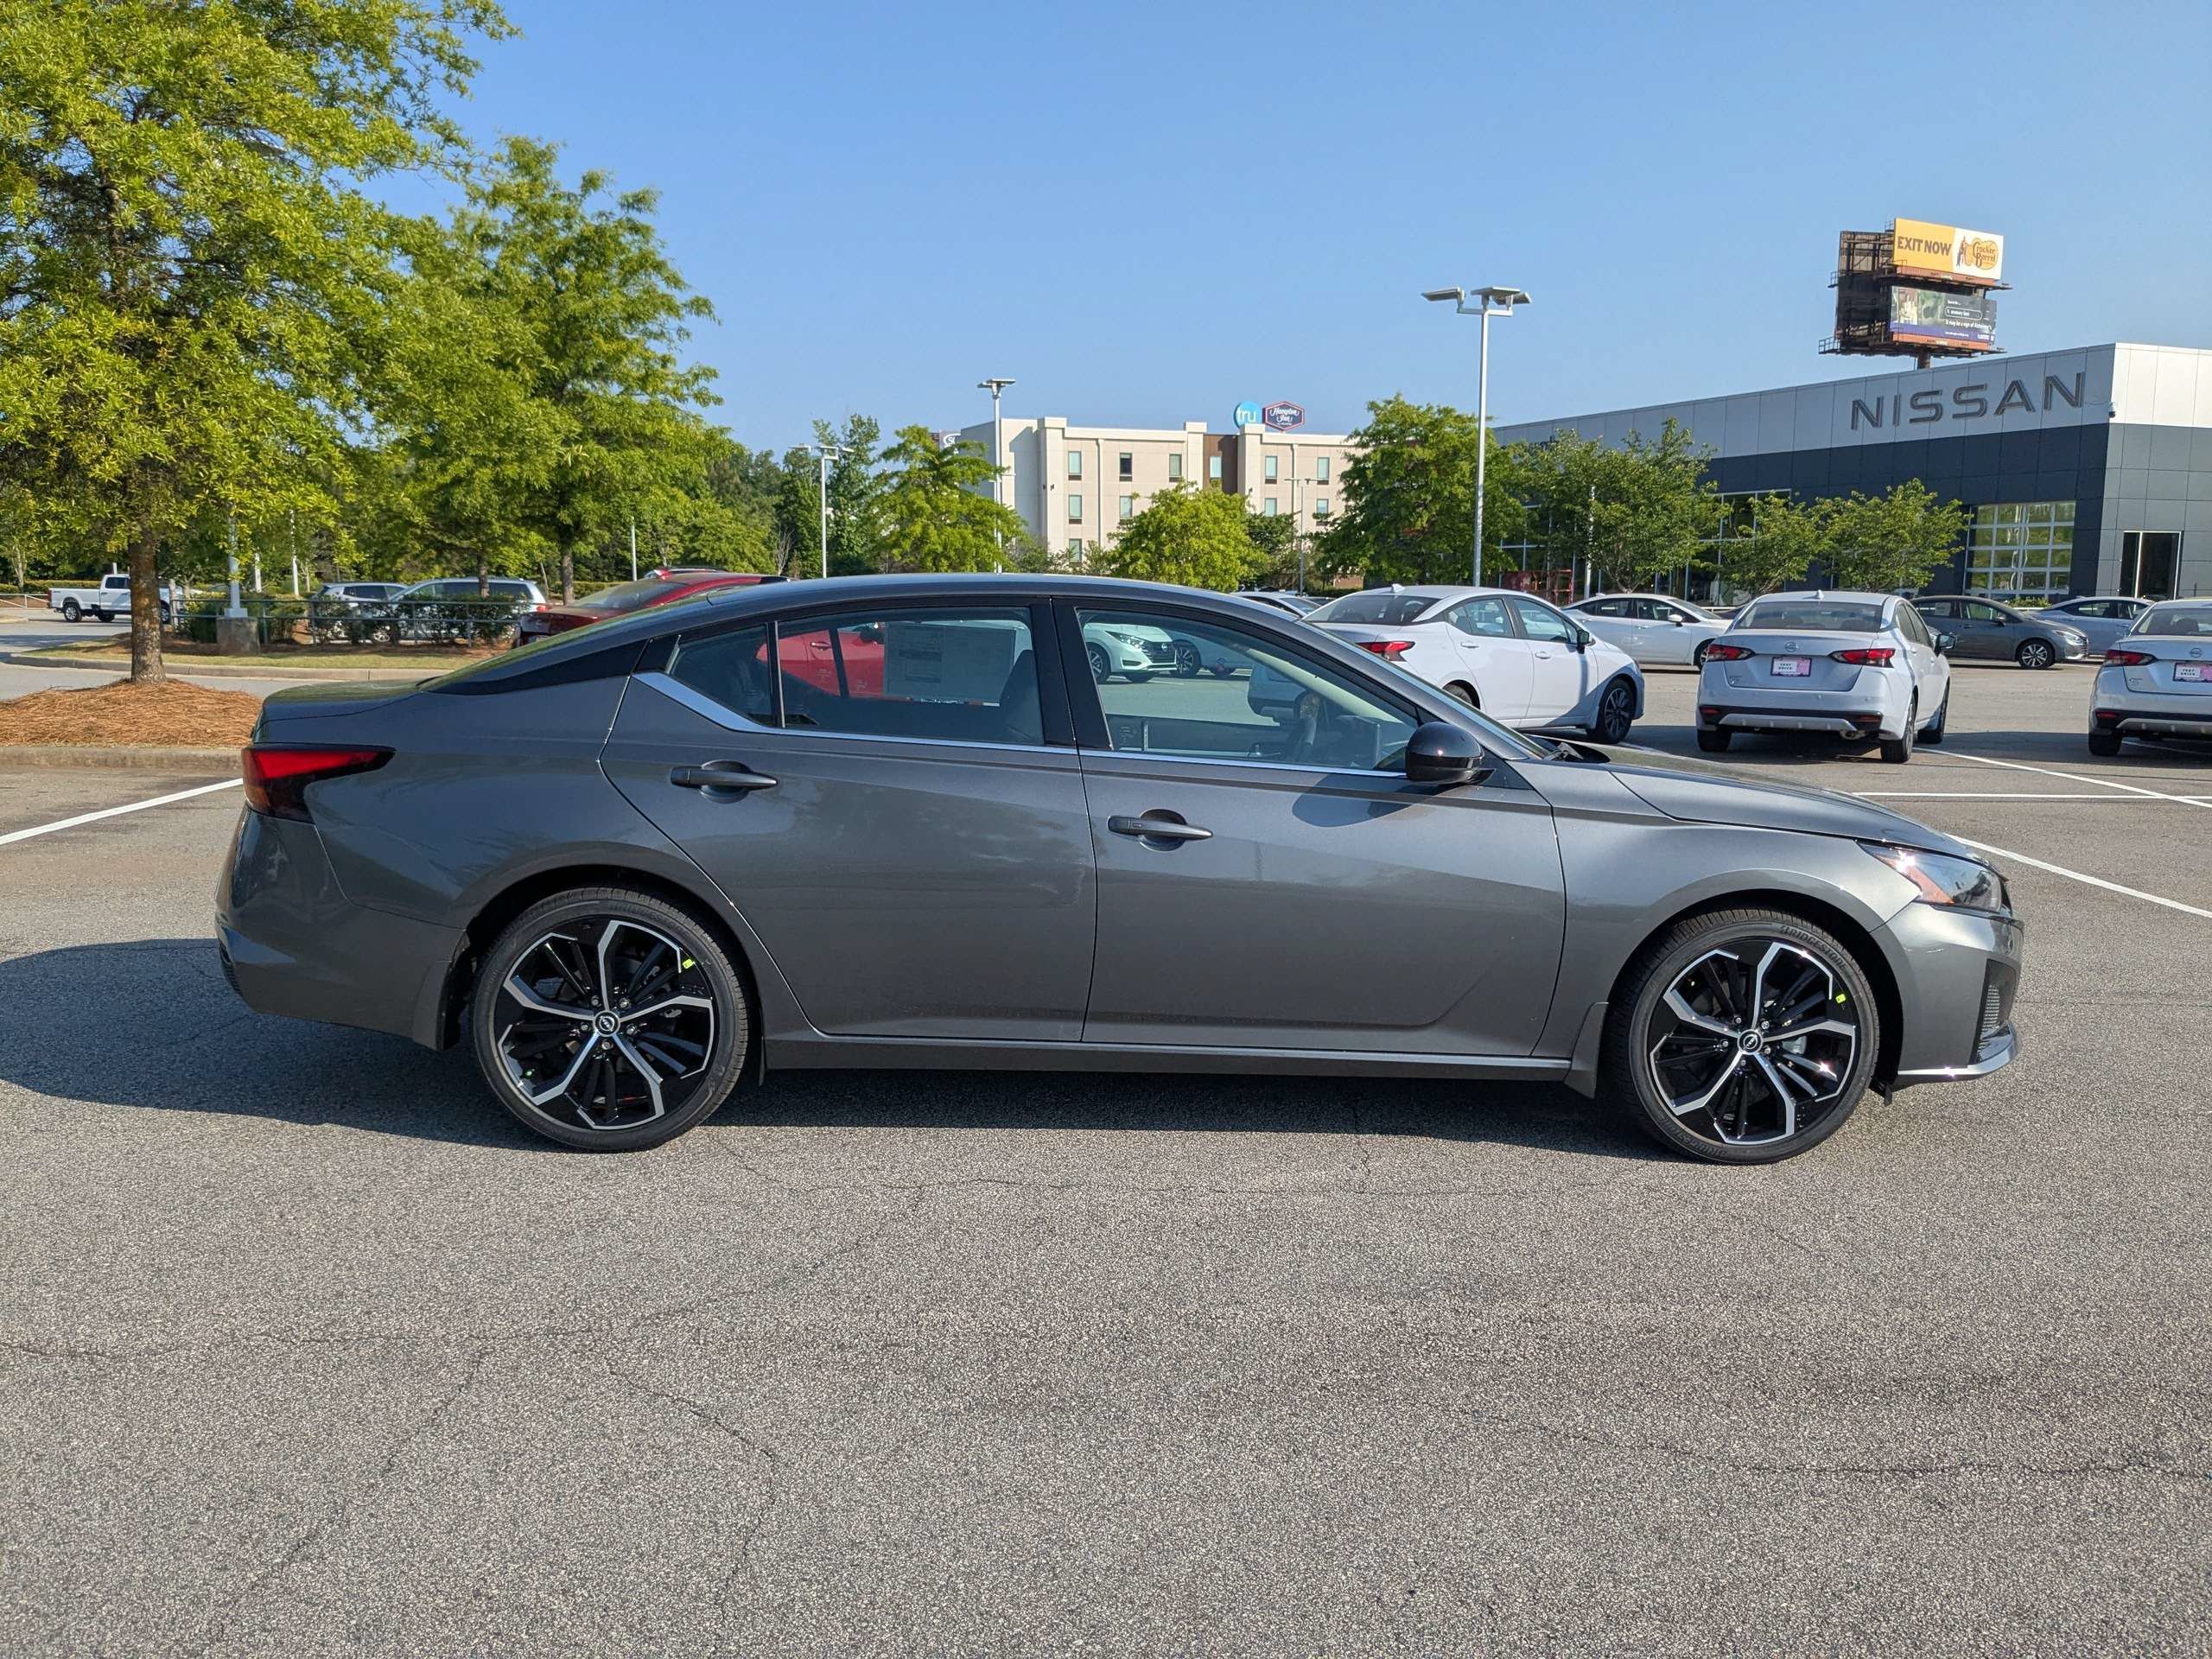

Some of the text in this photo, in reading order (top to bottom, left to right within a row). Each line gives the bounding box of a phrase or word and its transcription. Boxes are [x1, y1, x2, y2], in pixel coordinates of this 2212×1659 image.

[1897, 235, 1952, 256] EXIT NOW
[1973, 241, 1996, 257] Cracker
[1975, 252, 1996, 268] Barrel
[1851, 372, 2085, 430] NISSAN
[1236, 407, 1256, 423] tru
[1269, 407, 1300, 416] Hampton
[1780, 925, 1847, 970] BRIDGESTONE
